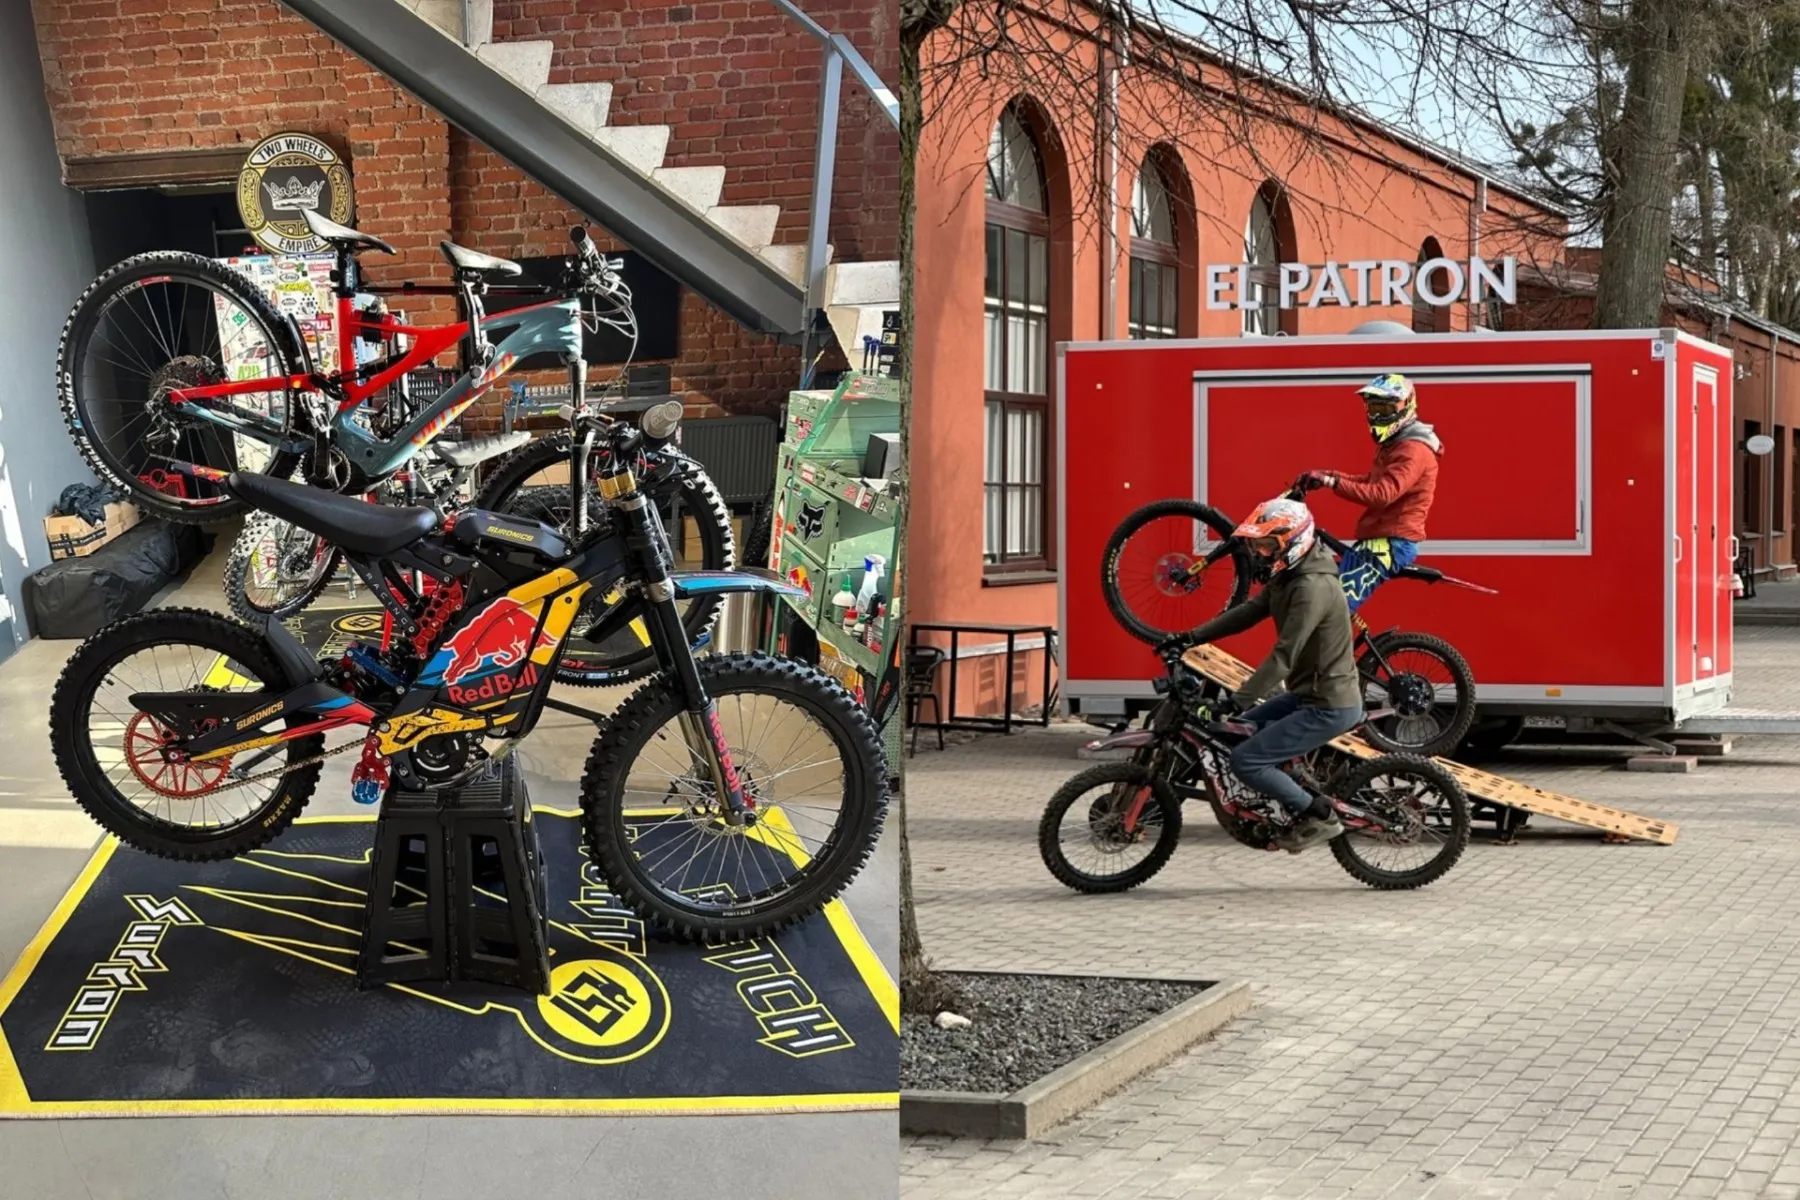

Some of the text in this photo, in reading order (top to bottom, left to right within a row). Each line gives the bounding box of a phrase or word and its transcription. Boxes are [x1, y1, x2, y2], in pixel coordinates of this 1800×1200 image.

[257, 138, 327, 161] TWO WHEELS
[278, 236, 321, 253] EMPIRE
[1206, 254, 1518, 311] EL PATRON
[63, 371, 77, 415] WILD
[79, 434, 123, 490] MICHELIN
[486, 525, 535, 542] SURONICS
[365, 572, 408, 626] RACING
[447, 662, 539, 704] Red Bull
[557, 669, 585, 679] FRONT
[236, 700, 284, 730] SURONICS
[721, 749, 741, 793] Bull
[263, 794, 292, 828] MAXXIS
